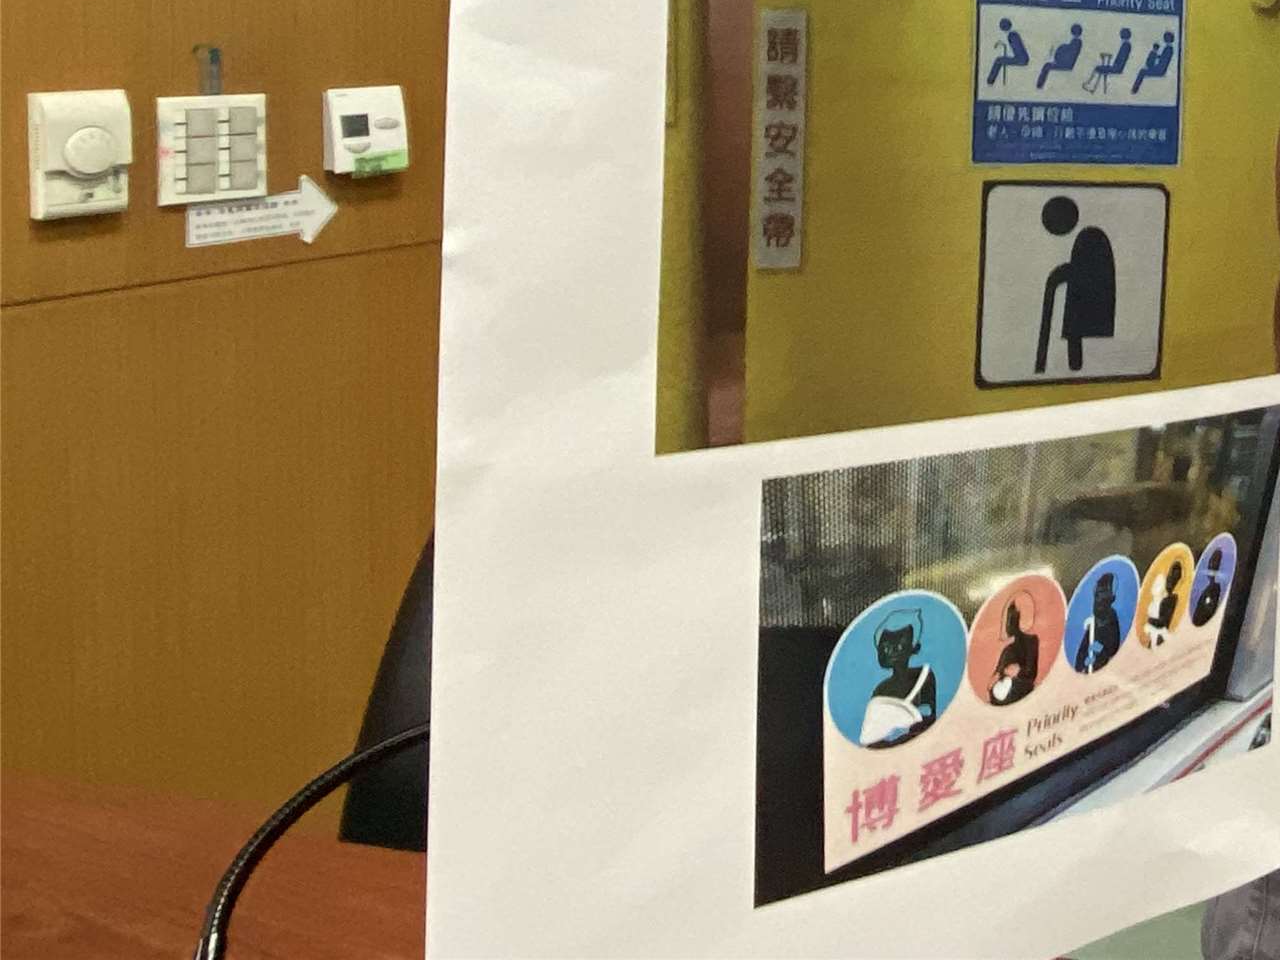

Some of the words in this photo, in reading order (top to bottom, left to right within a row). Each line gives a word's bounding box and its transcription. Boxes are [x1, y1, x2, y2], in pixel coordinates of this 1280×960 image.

[1026, 699, 1079, 737] Priority
[1023, 732, 1064, 761] Seats
[845, 727, 1018, 843] 博愛座
